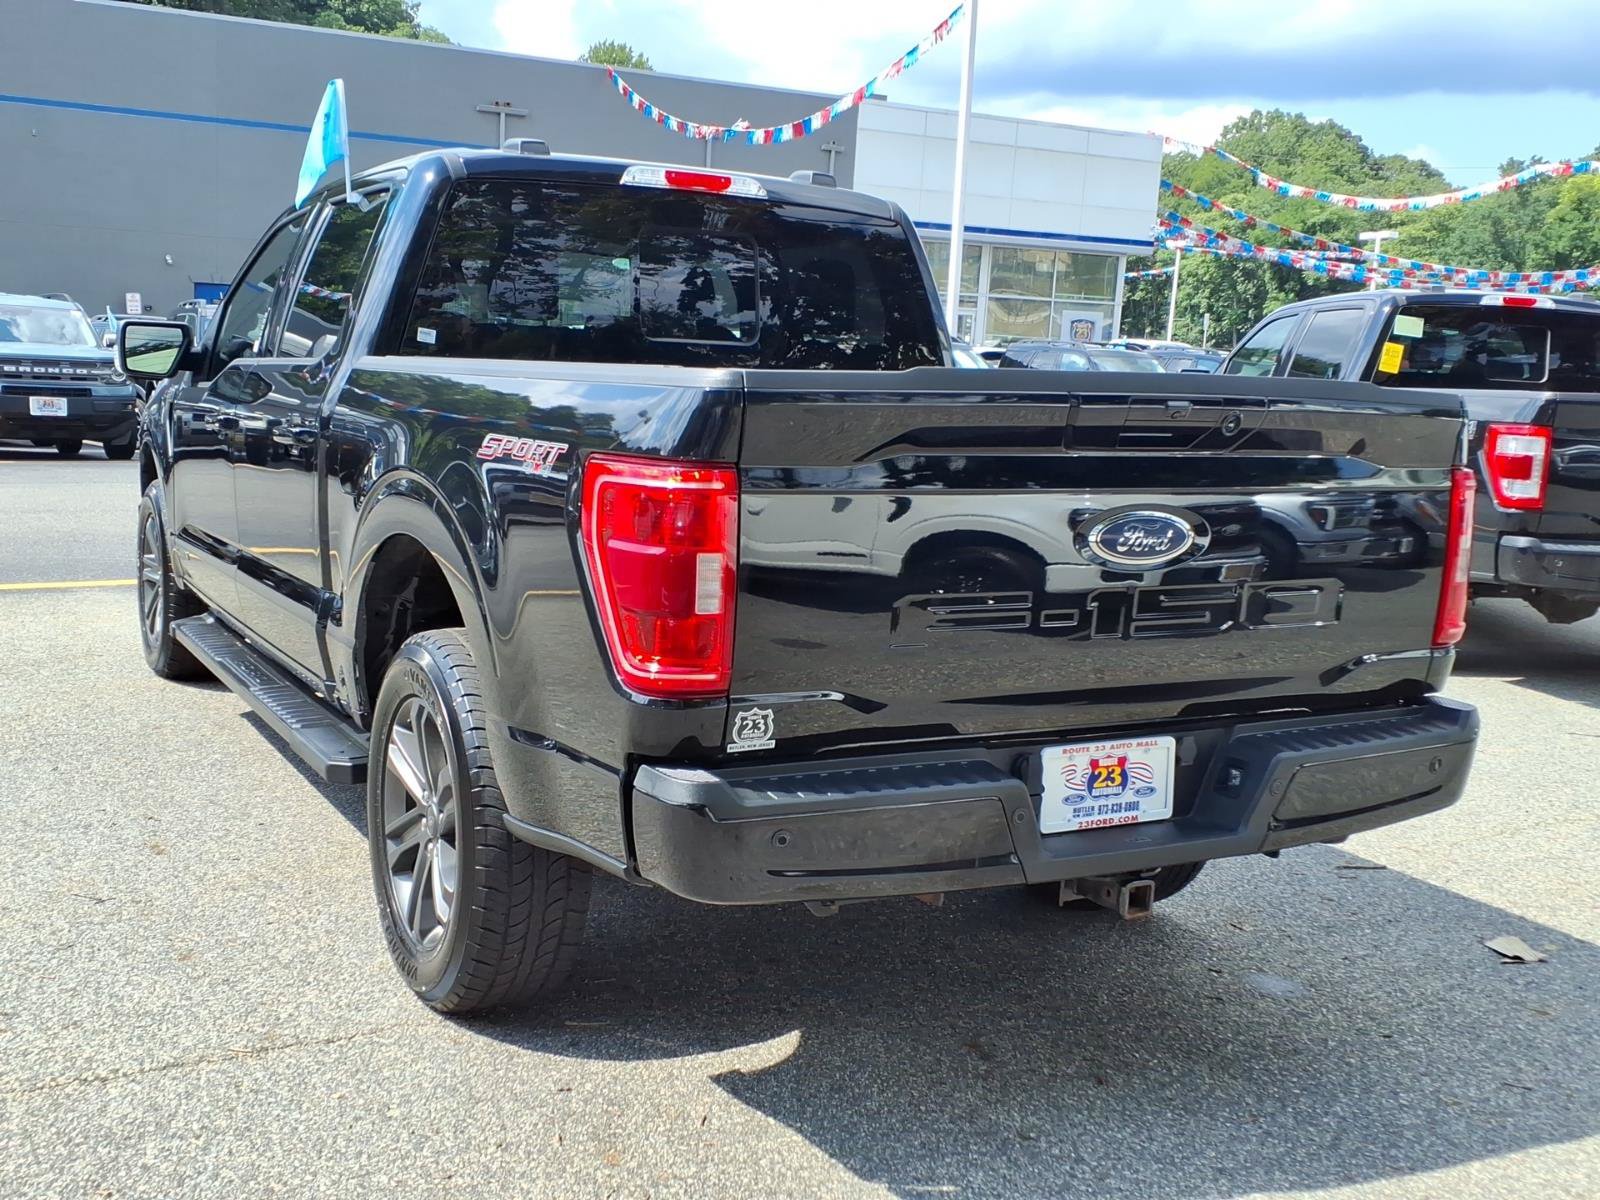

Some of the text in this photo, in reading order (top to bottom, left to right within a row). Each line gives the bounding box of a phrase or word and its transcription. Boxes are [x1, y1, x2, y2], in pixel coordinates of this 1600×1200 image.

[3, 366, 88, 375] BRONCO
[476, 432, 569, 465] SPORT
[1116, 523, 1174, 552] Ford
[889, 577, 1345, 649] F-150
[742, 719, 766, 734] 23
[1062, 746, 1090, 755] ROUTE
[1109, 742, 1133, 750] AUTO
[1135, 740, 1158, 748] MALL
[1093, 765, 1122, 788] 23
[1072, 806, 1095, 814] BUTLER
[1078, 815, 1139, 829] 23FORD.COM
